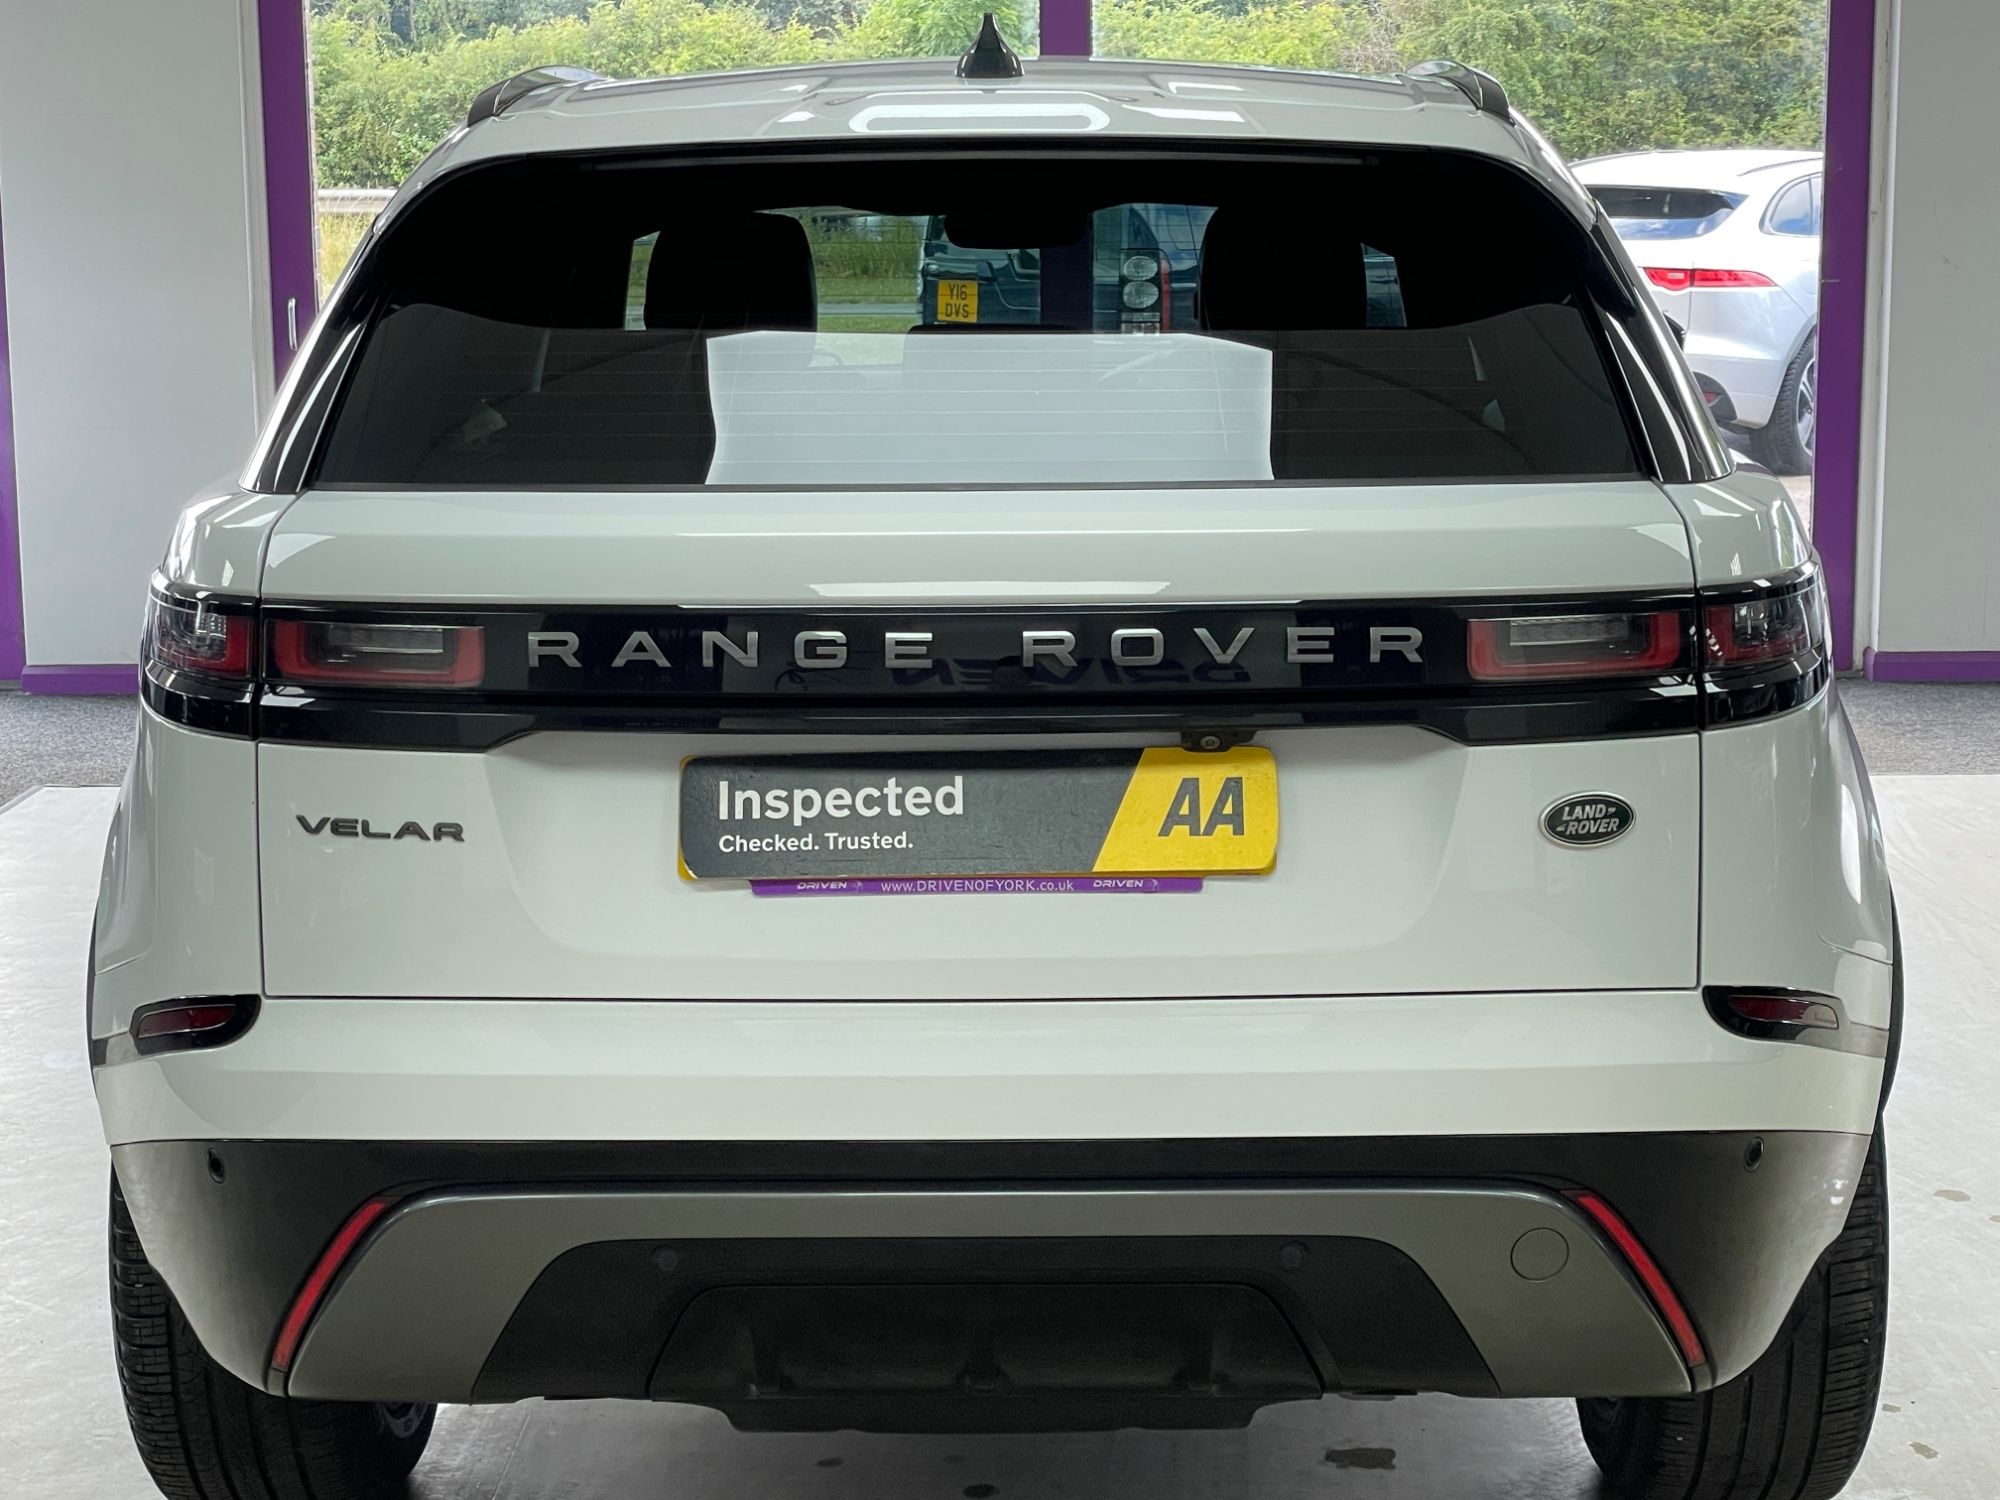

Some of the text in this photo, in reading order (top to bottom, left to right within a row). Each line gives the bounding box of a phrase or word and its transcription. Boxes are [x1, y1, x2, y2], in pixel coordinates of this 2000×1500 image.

[948, 283, 968, 300] Y16
[945, 303, 969, 318] DVS
[527, 626, 1424, 669] RANGE ROVER
[718, 776, 1245, 837] Inspected AA
[1562, 804, 1606, 820] LAND
[296, 815, 465, 842] VELAR
[1566, 818, 1620, 835] ROVER
[718, 831, 914, 853] Checked. Trusted.
[797, 879, 1144, 892] DRIVEN www.DRIVENOFYORK.co.uk DRIVEN
